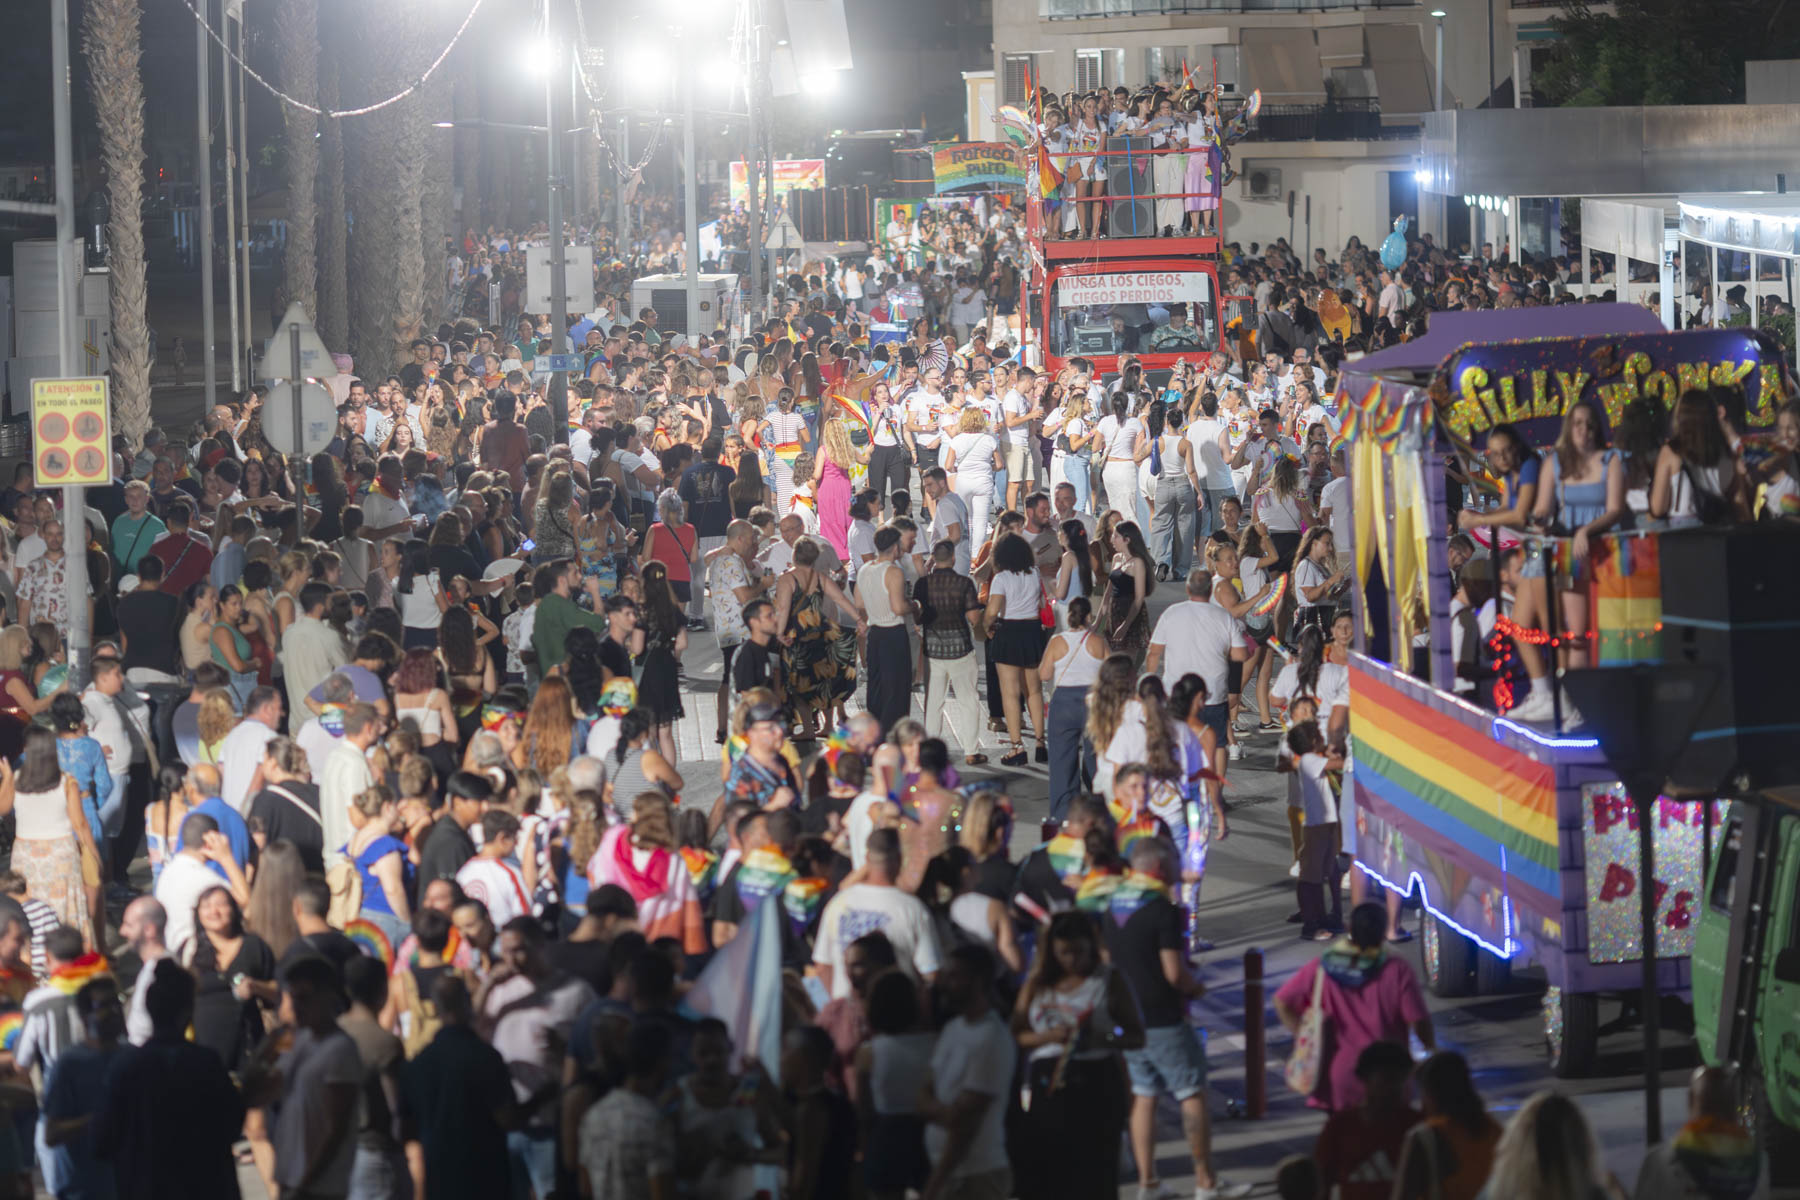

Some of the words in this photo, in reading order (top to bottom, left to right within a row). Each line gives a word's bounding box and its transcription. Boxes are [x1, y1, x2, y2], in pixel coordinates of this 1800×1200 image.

[1058, 276, 1106, 291] MURGA
[1110, 274, 1133, 288] LOS
[1136, 273, 1185, 288] CIEGOS,
[1071, 290, 1116, 304] CIEGOS
[1447, 364, 1592, 444] WILLY
